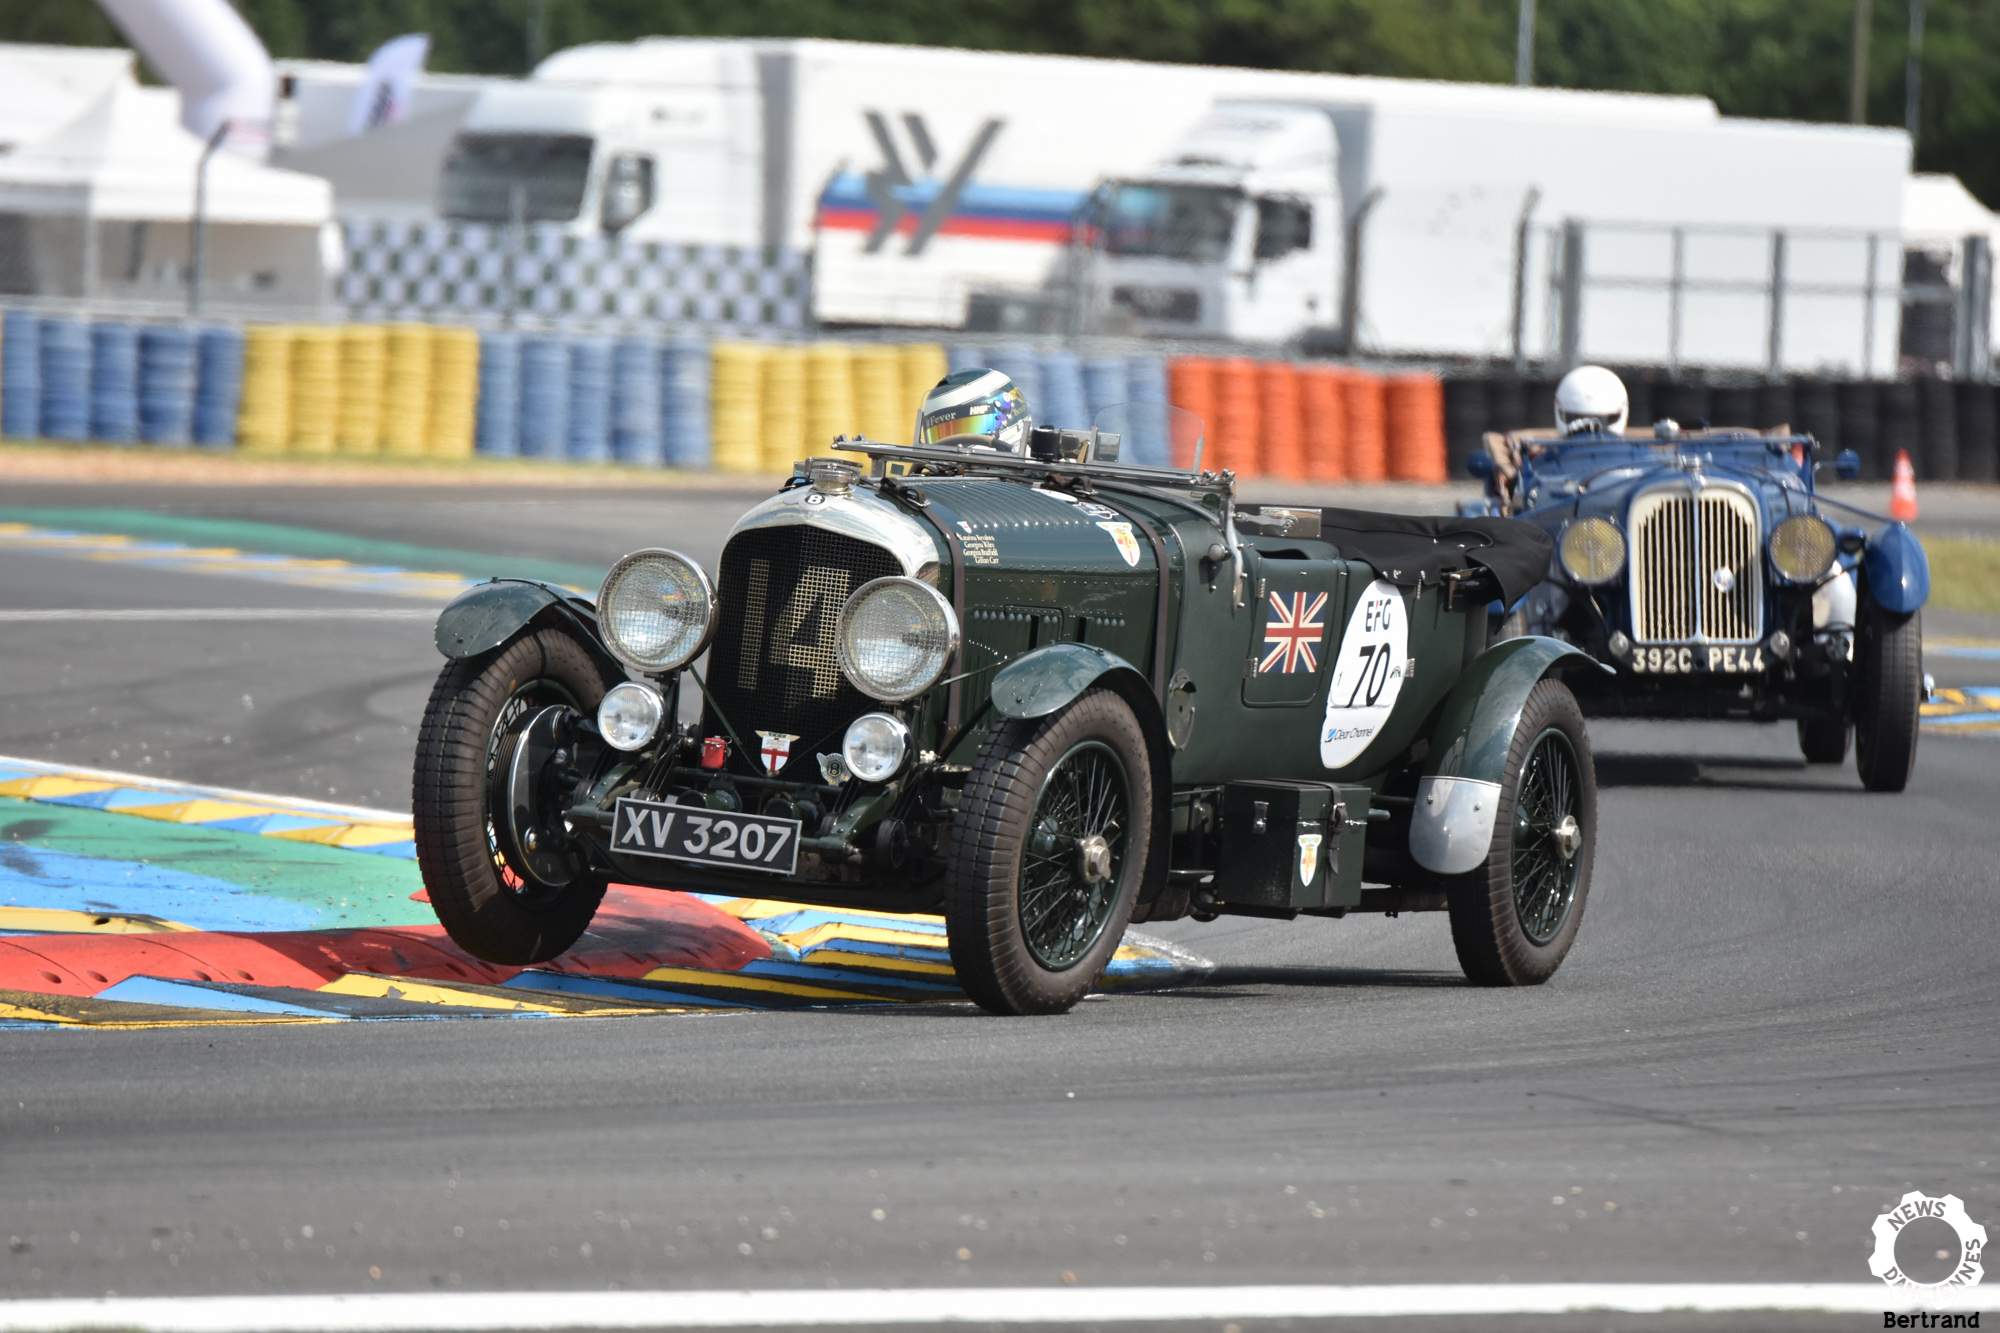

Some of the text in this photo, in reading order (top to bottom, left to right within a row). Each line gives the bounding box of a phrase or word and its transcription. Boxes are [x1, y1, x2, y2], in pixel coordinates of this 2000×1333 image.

[738, 558, 850, 700] 14
[1365, 598, 1392, 632] EFG
[1344, 642, 1391, 709] 70
[1632, 647, 1765, 673] 392C PE44
[1334, 725, 1375, 740] Clear Channel
[621, 806, 792, 862] XV 3207
